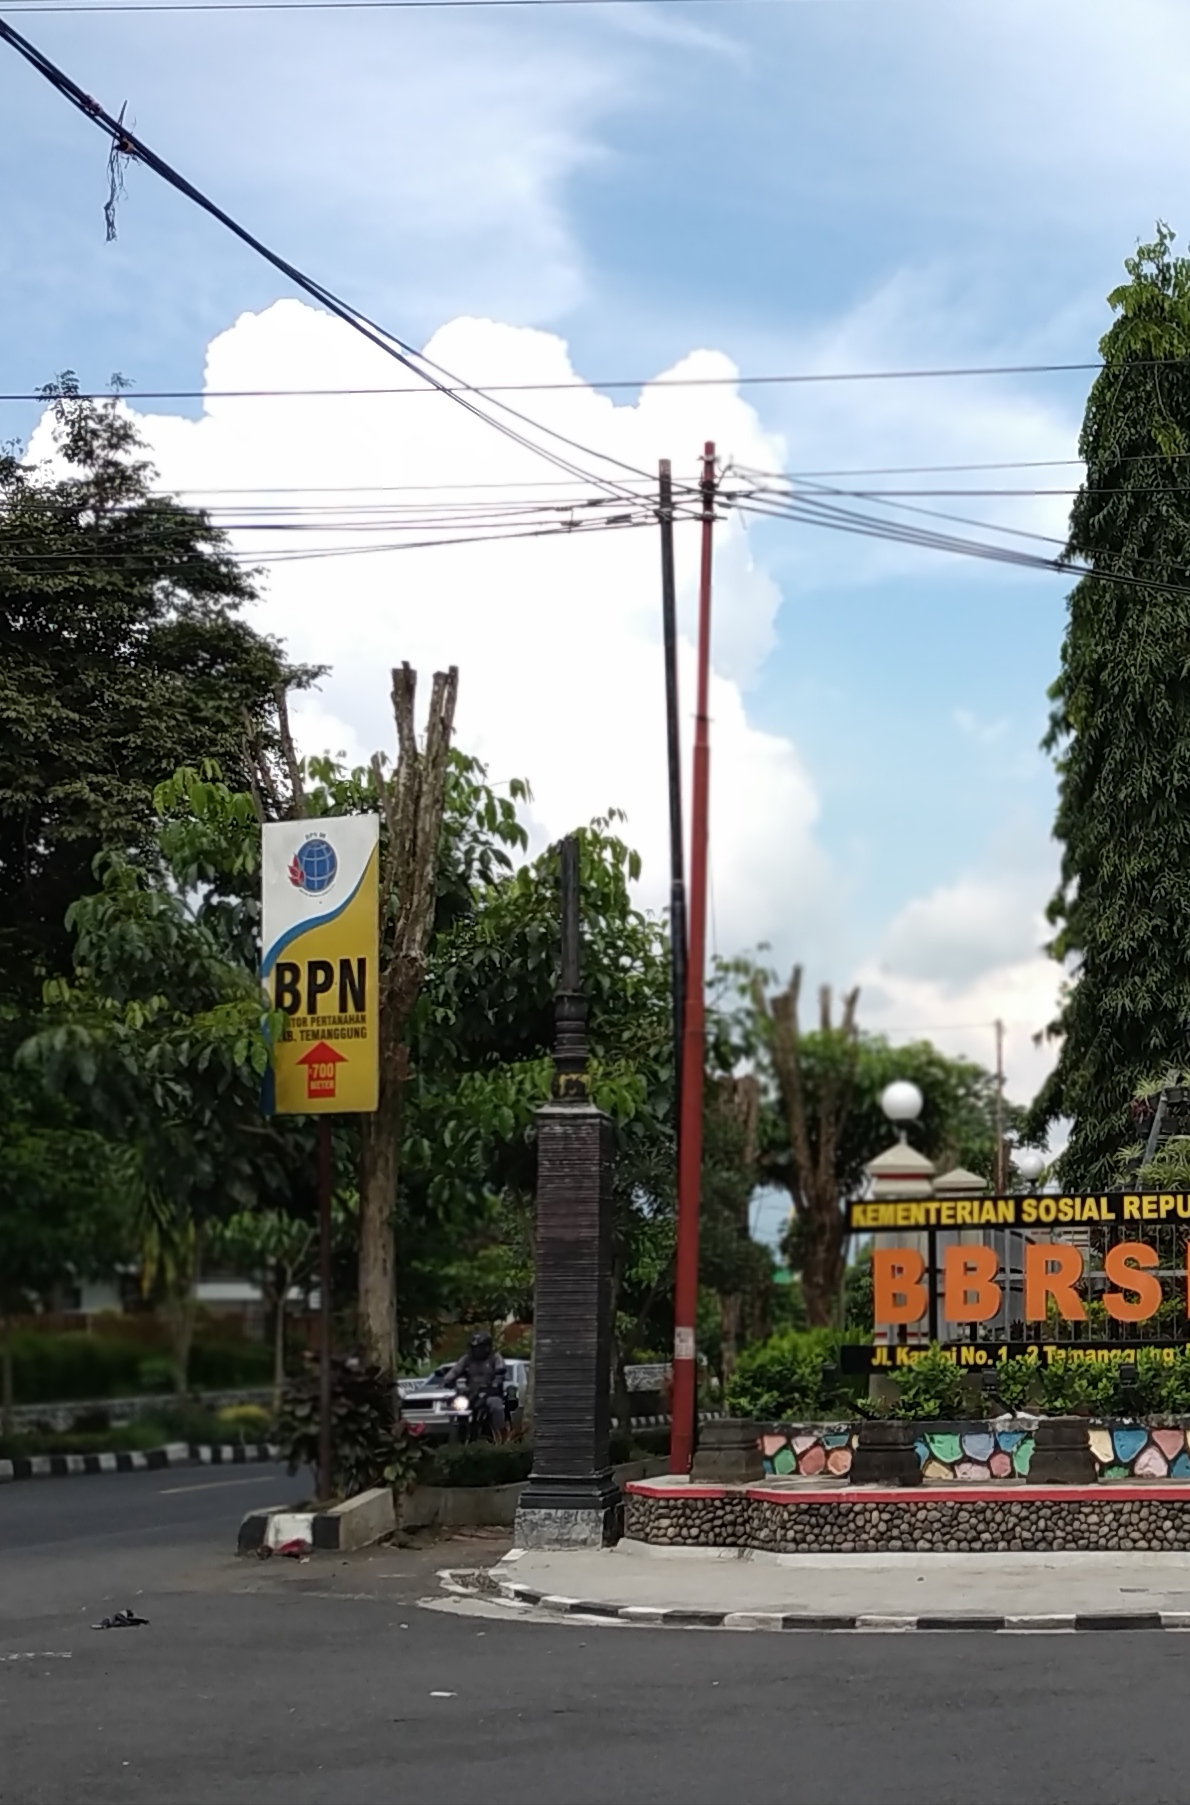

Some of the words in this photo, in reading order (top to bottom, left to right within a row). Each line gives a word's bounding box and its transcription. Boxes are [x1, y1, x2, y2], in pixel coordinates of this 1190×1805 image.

[274, 958, 367, 1016] BPN
[310, 1014, 367, 1027] PERTANAHAN
[300, 1026, 368, 1042] TEMANGGUNG
[850, 1199, 1016, 1228] KEMENTERIAN
[1021, 1196, 1116, 1223] SOSIAL
[960, 1346, 993, 1366] No.
[998, 1345, 1008, 1364] 1
[1026, 1345, 1039, 1365] 2
